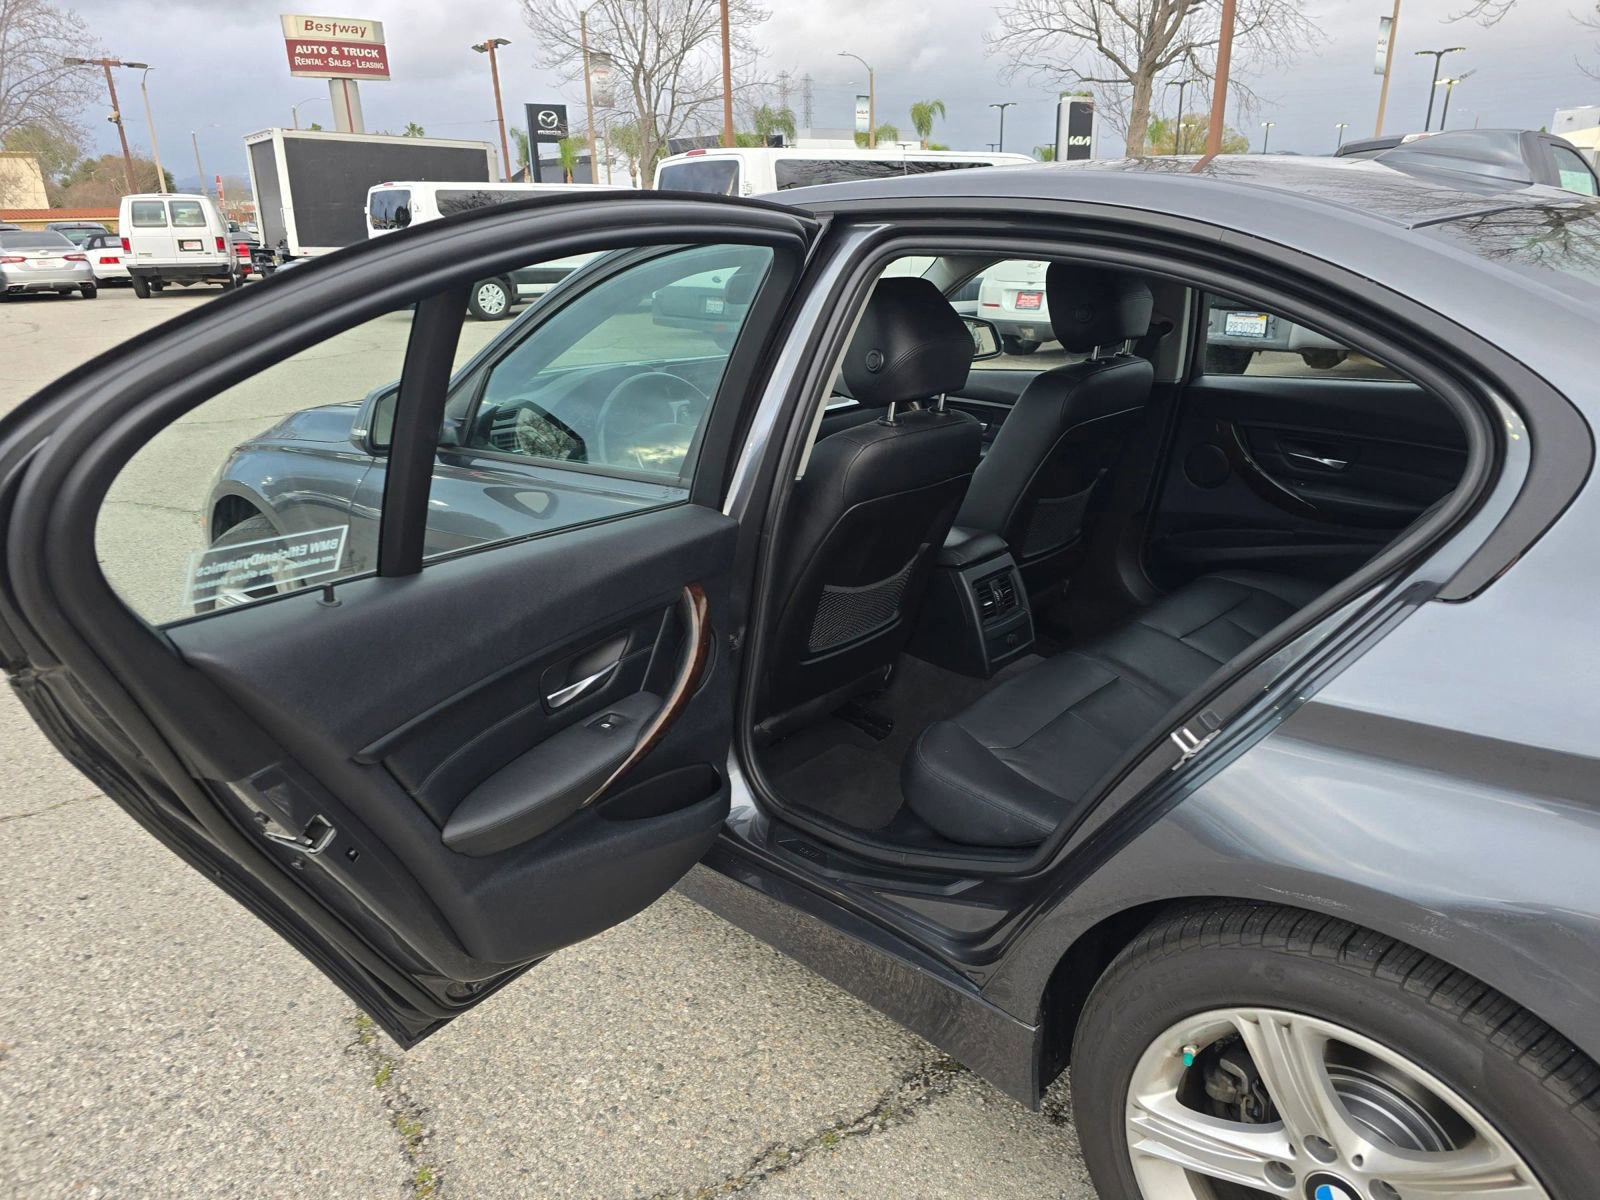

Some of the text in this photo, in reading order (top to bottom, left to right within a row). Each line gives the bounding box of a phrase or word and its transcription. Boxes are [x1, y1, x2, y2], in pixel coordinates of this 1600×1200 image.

[304, 20, 367, 38] Bestway
[295, 45, 379, 58] AUTO & TRUCK
[294, 56, 384, 69] RENTAL SALES LEASING
[1069, 135, 1090, 147] KIA
